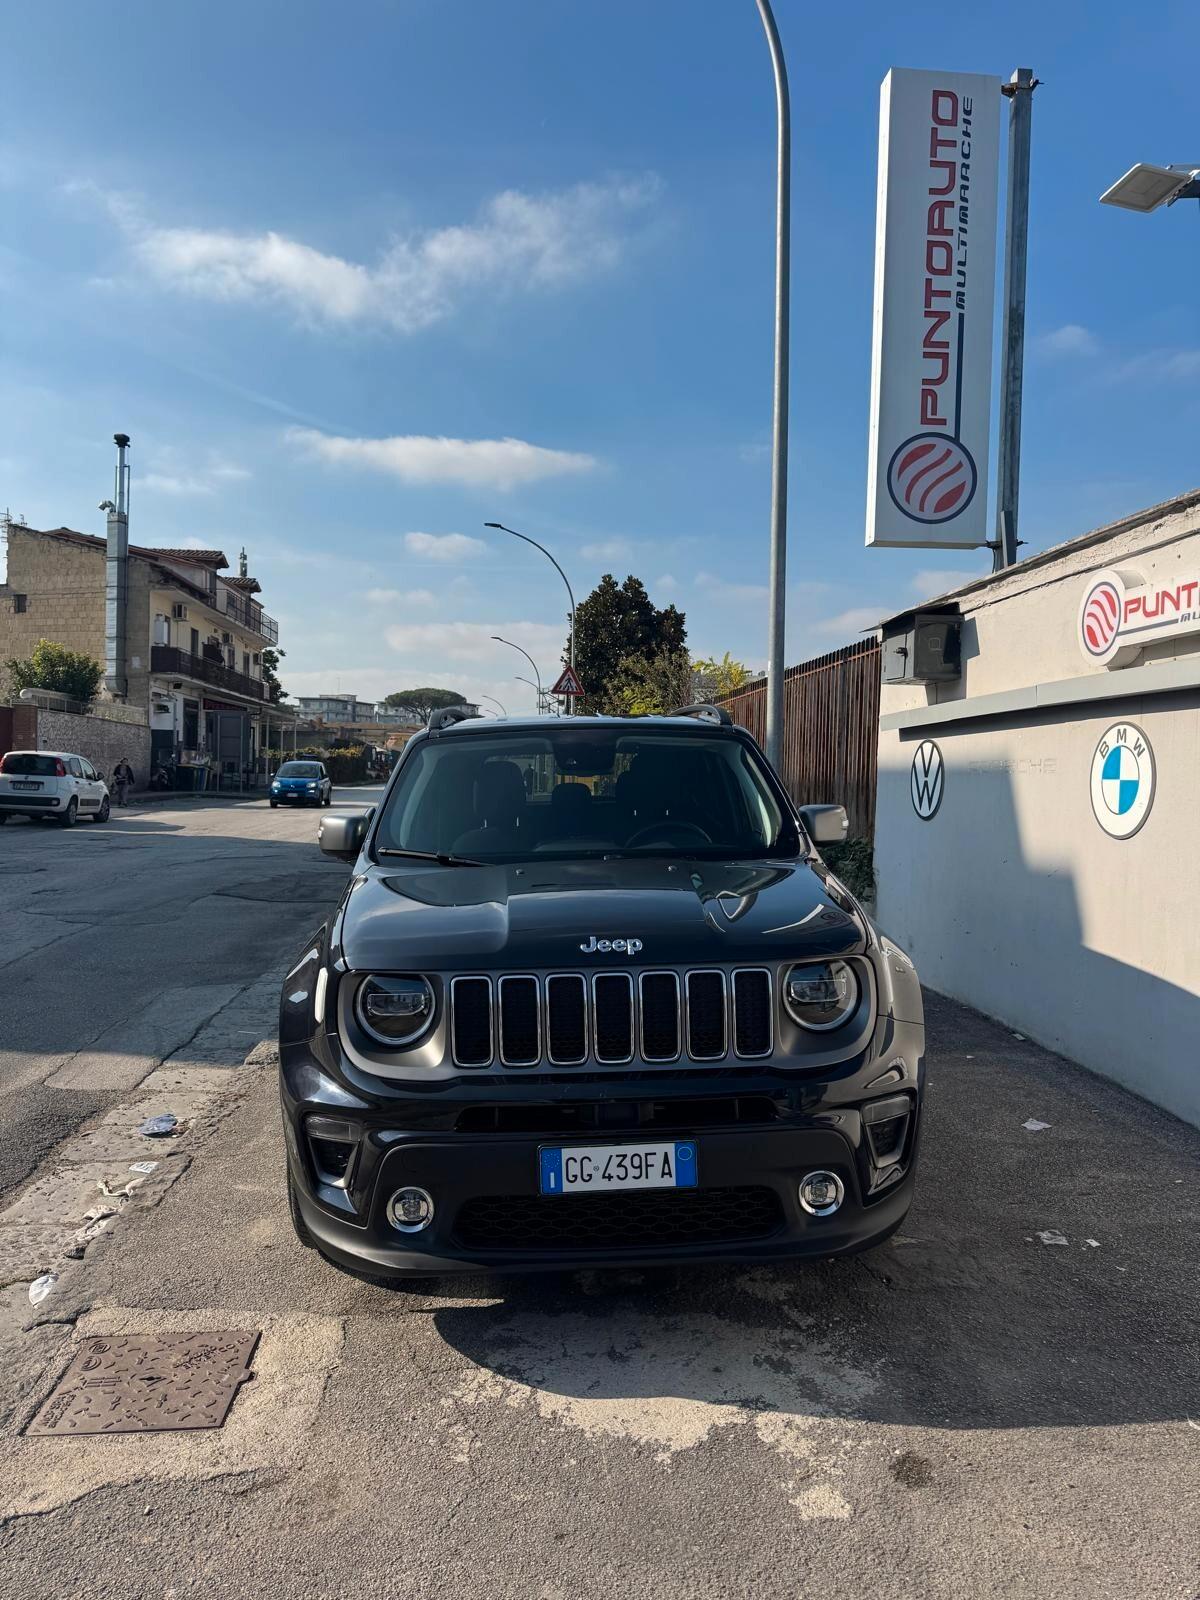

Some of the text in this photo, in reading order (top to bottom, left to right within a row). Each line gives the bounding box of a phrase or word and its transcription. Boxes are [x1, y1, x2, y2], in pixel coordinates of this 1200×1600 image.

[955, 95, 973, 311] MULTIMARCHE
[920, 89, 959, 426] PUNTOAUTO
[1123, 581, 1200, 624] PUNT
[1099, 728, 1146, 760] BMW
[580, 936, 643, 955] Jeep
